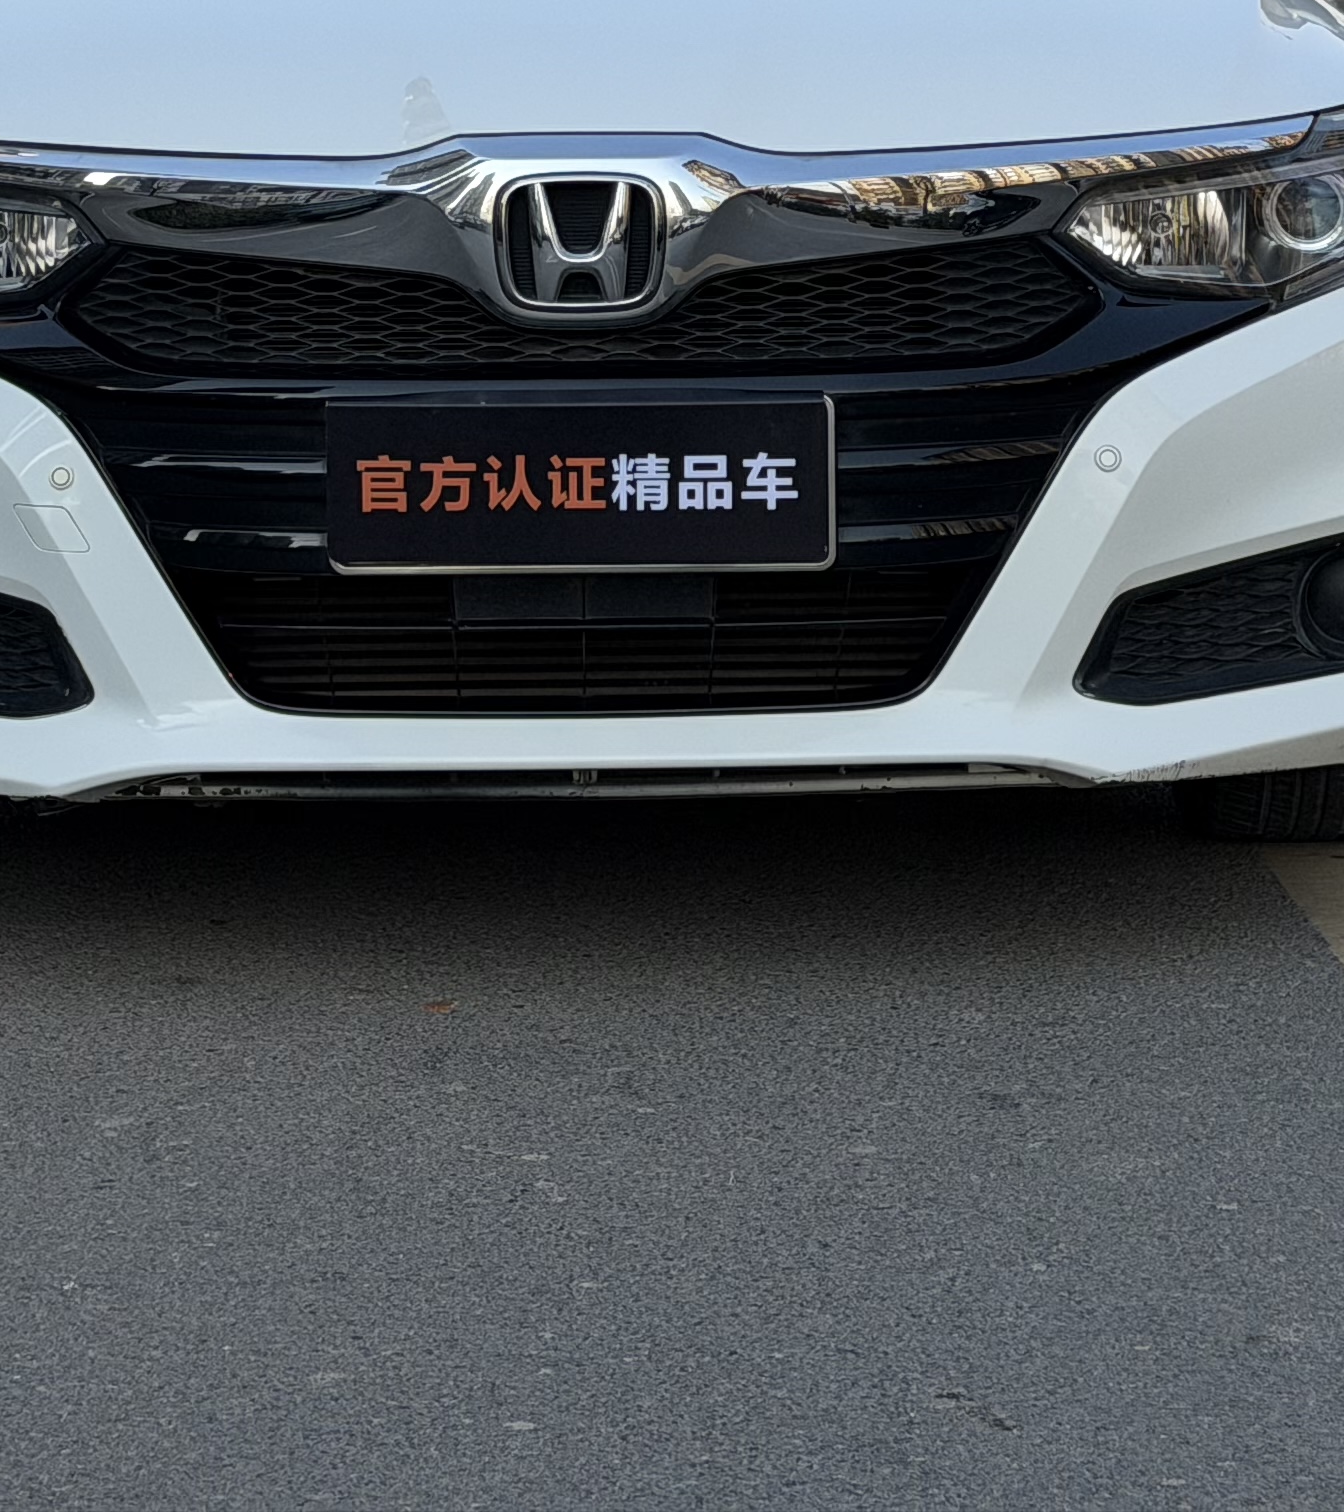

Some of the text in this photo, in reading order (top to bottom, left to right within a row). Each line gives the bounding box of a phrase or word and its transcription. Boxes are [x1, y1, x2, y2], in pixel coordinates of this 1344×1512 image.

[355, 452, 799, 513] 官方认证精品车
